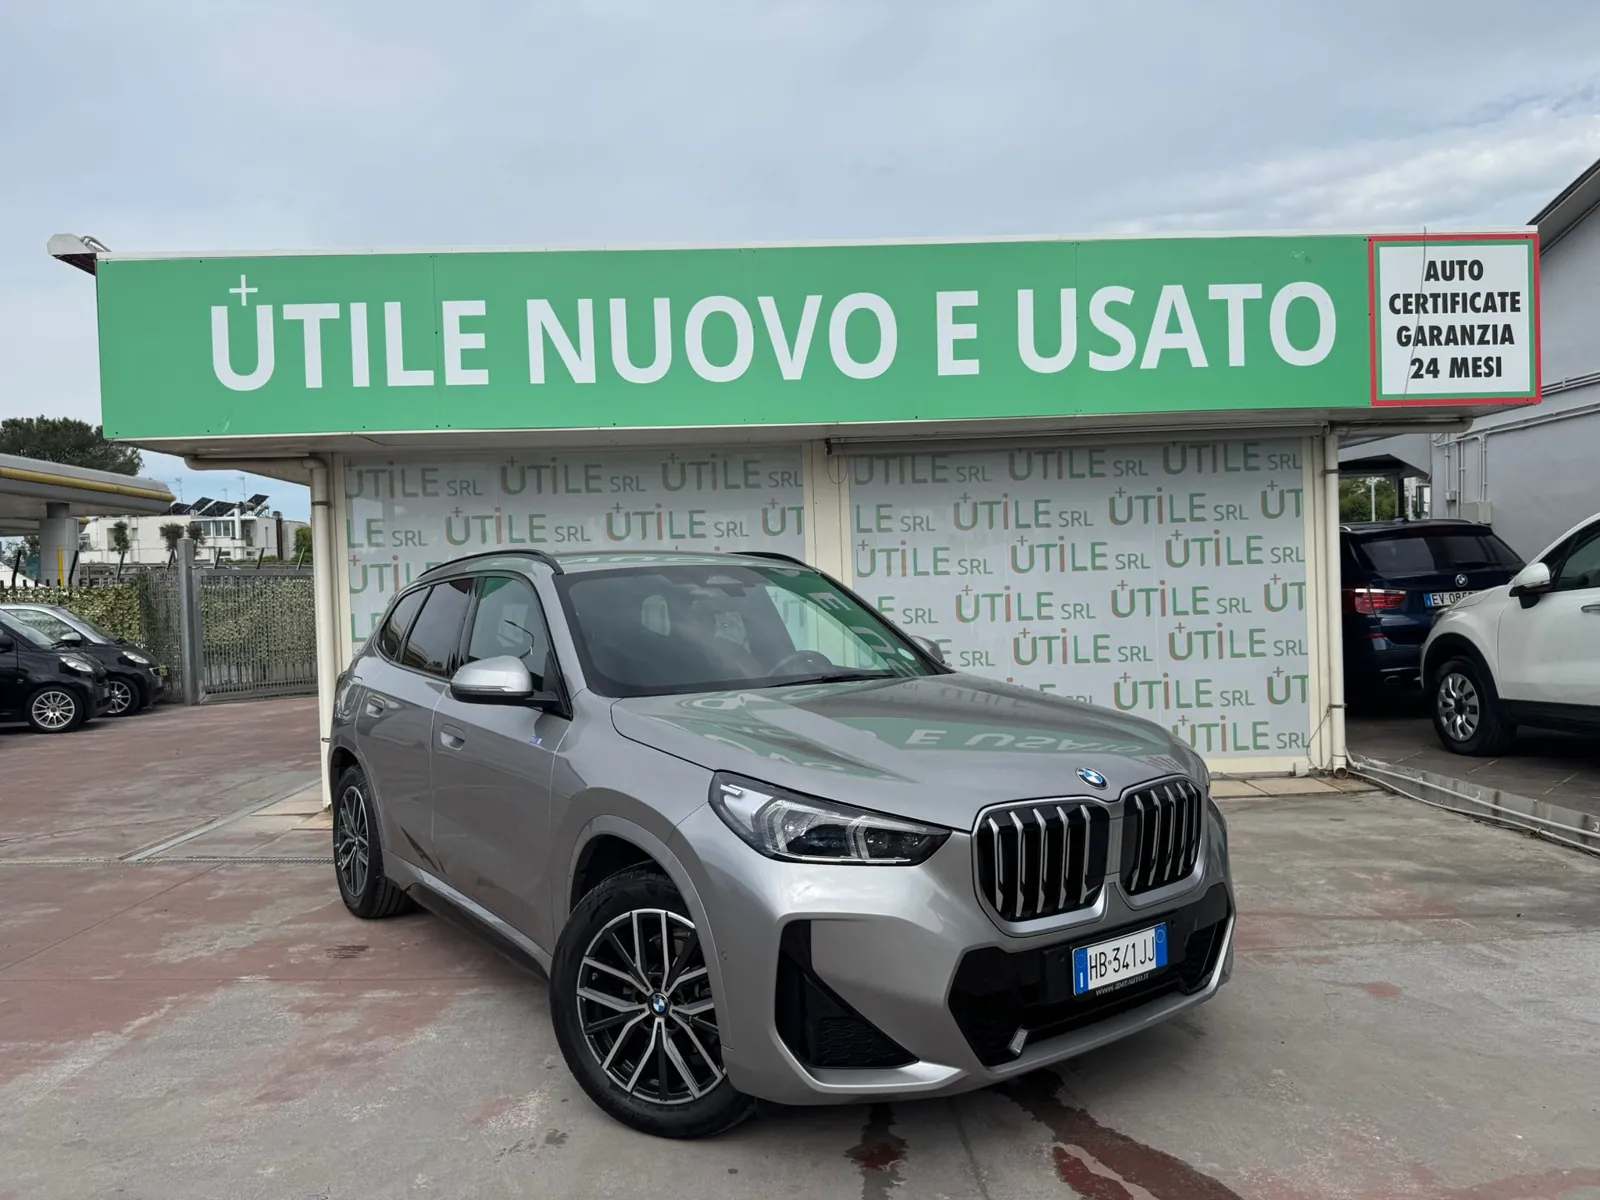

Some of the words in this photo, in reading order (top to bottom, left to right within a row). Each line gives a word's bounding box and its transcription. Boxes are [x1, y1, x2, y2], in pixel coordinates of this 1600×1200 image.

[1424, 259, 1484, 282] AUTO
[1389, 292, 1521, 314] CERTIFICATE
[526, 293, 898, 385] NUOVO
[936, 291, 980, 376] E
[1016, 282, 1337, 373] USATO
[1396, 324, 1515, 347] GARANZIA
[1410, 357, 1440, 379] 24
[1449, 356, 1502, 378] MESI
[1114, 461, 1148, 477] SRL
[1267, 453, 1302, 469] SRL
[769, 472, 803, 487] SRL
[956, 466, 991, 482] SRL
[447, 480, 482, 496] SRL
[610, 476, 646, 492] SRL
[856, 504, 893, 532] LE
[901, 517, 936, 532] SRL
[1058, 510, 1093, 526] SRL
[1213, 504, 1248, 520] SRL
[347, 519, 383, 547] LE
[392, 530, 428, 546] SRL
[555, 526, 590, 542] SRL
[714, 521, 749, 537] SRL
[1115, 553, 1150, 569] SRL
[1270, 547, 1305, 563] SRL
[957, 558, 993, 575] SRL
[1061, 603, 1095, 619] SRL
[1217, 598, 1252, 614] SRL
[903, 608, 938, 623] SRL
[1118, 645, 1152, 662] SRL
[1273, 640, 1307, 655] SRL
[960, 651, 995, 667] SRL
[1220, 690, 1254, 706] SRL
[1277, 733, 1310, 748] SRL
